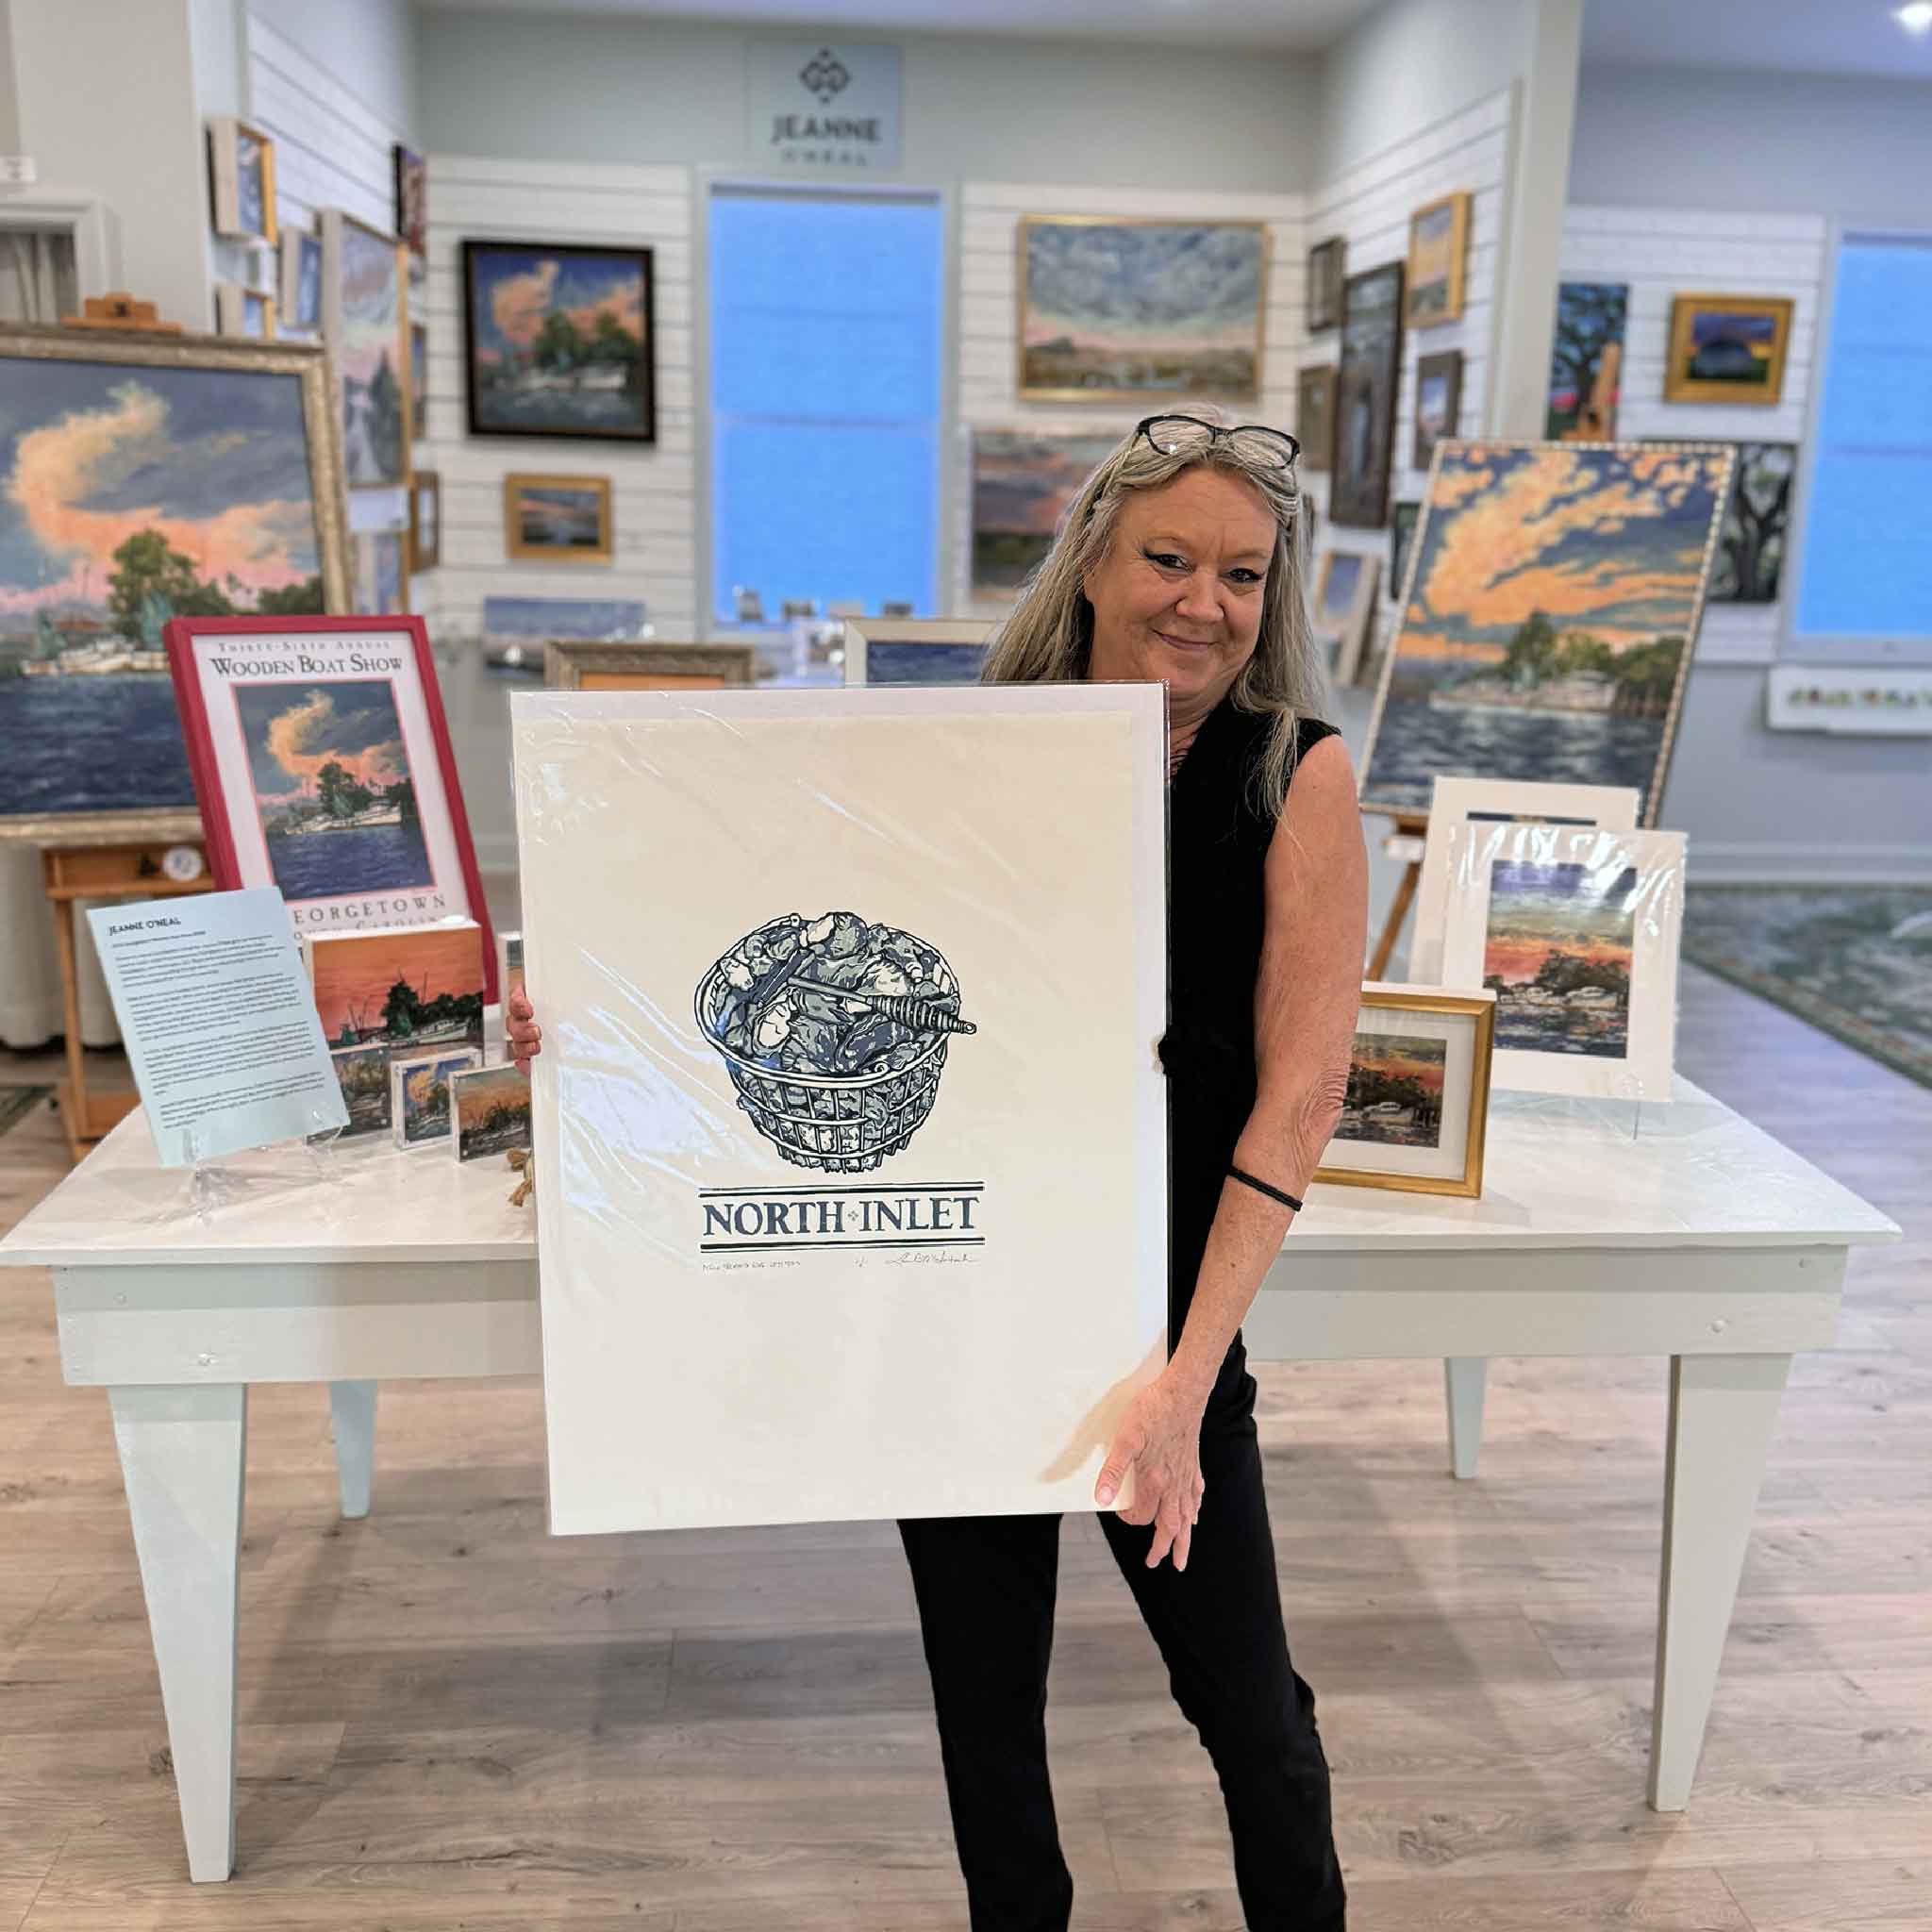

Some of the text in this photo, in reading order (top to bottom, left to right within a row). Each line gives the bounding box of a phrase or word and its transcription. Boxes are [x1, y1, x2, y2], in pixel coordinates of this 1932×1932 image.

[209, 653, 403, 677] WOODEN BOAT SHOW
[293, 894, 446, 925] EORGETOWN
[703, 1196, 980, 1237] NORTH INLET
